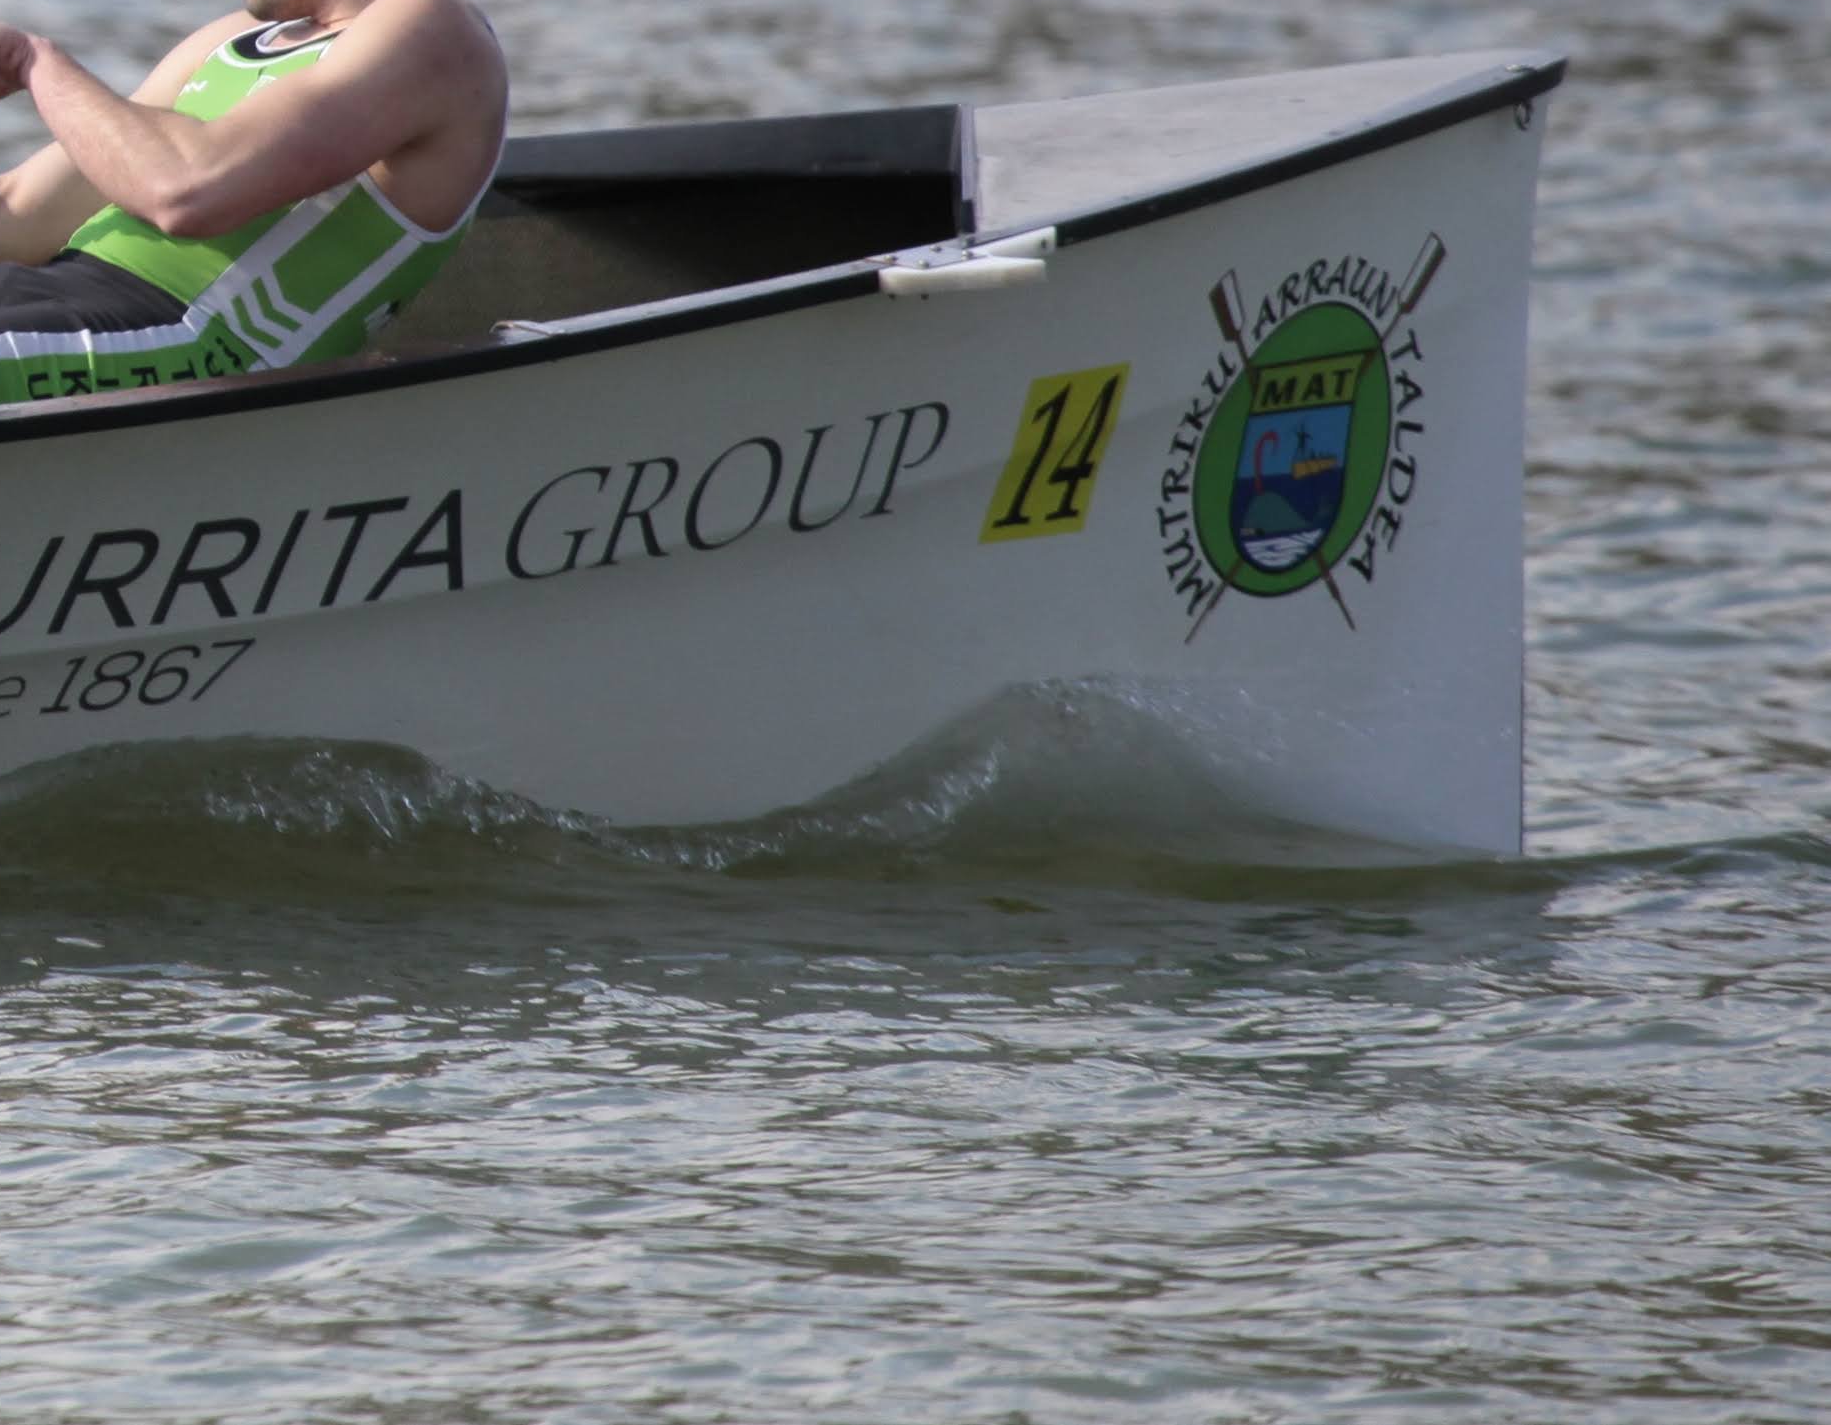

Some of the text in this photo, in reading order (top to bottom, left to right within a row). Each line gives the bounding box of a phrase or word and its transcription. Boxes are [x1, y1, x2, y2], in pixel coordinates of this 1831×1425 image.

[992, 373, 1120, 529] 14
[1157, 255, 1425, 616] MUTRIKU ARRAUN TALDEA
[1261, 370, 1354, 407] MAT
[505, 401, 949, 579] GROUP
[39, 638, 255, 714] 1867
